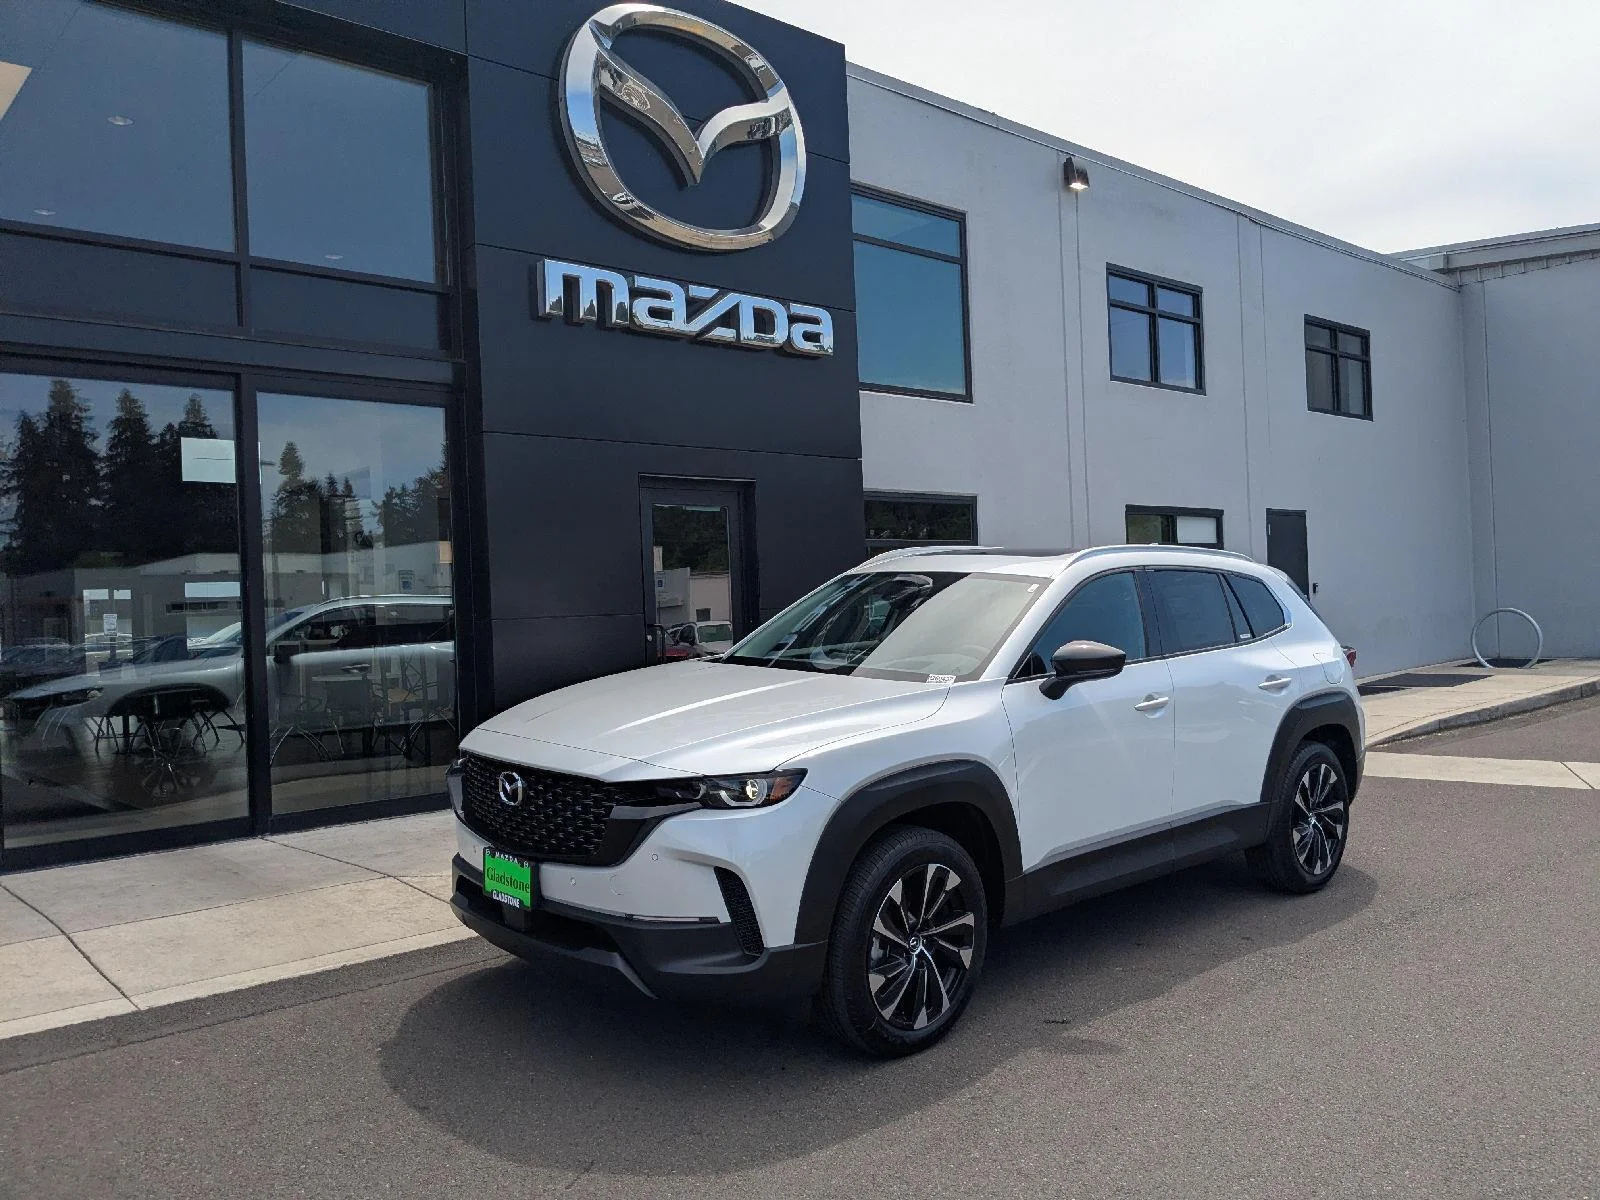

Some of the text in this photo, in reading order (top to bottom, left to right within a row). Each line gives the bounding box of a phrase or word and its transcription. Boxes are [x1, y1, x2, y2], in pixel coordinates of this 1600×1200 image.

[495, 851, 518, 864] MAZDA
[486, 866, 530, 893] Gladstone
[492, 890, 520, 908] GLADSTONE
